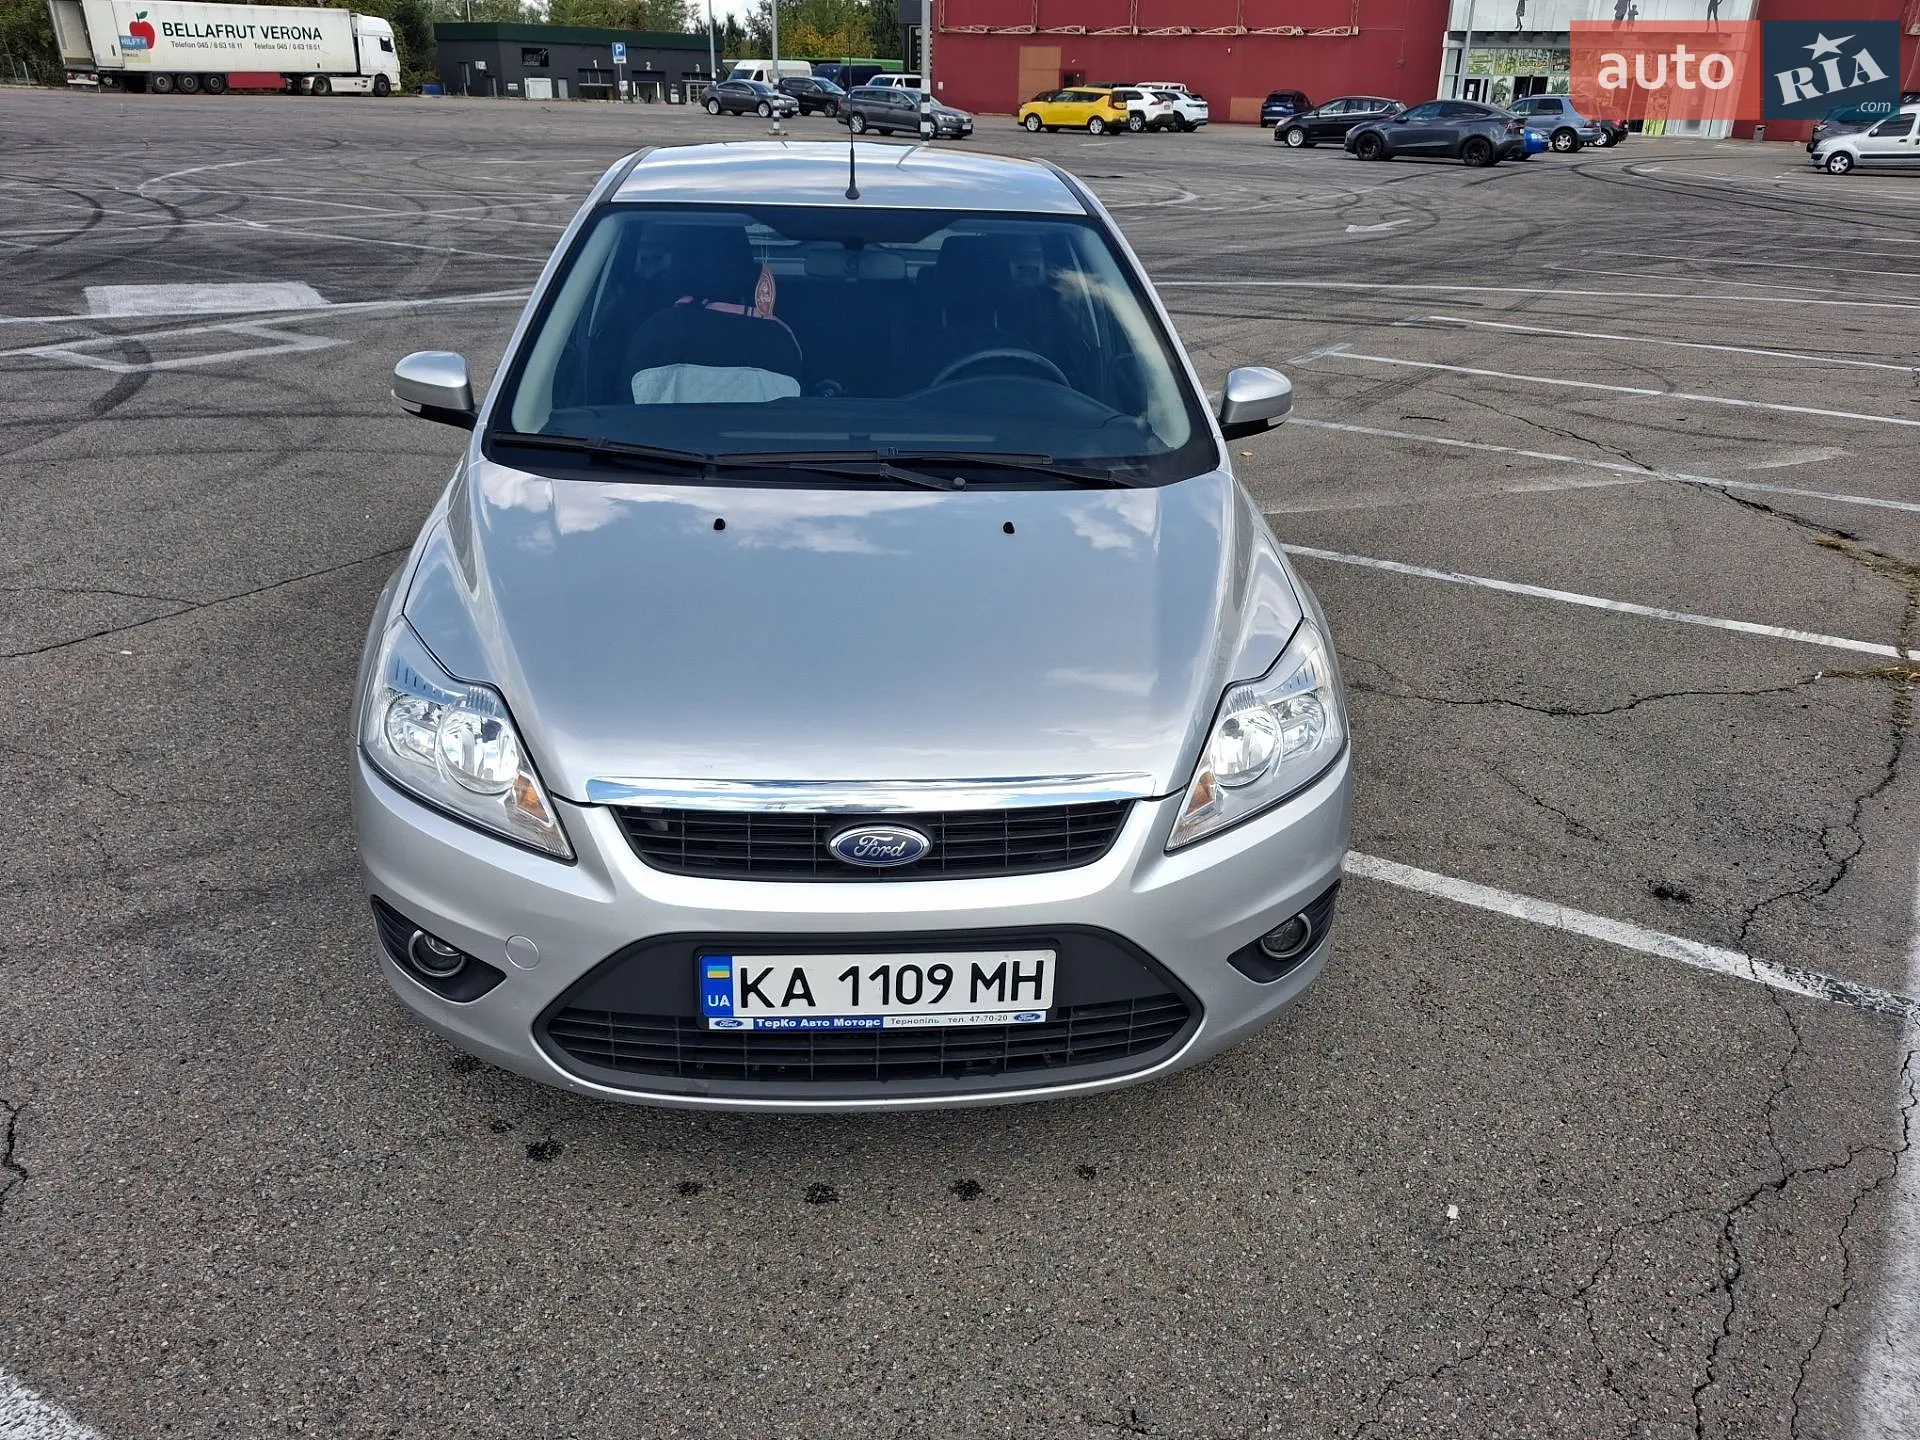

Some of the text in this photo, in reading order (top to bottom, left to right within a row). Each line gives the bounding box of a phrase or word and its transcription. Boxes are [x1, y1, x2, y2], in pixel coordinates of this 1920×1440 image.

[162, 22, 323, 40] BELLAFRUT VERONA
[615, 44, 623, 56] P
[854, 835, 906, 857] Ford
[740, 960, 1044, 1008] KA 1109 MH
[708, 994, 730, 1007] UA
[756, 1017, 881, 1028] ТерКо Авто Моторс
[891, 1016, 940, 1025] Тернопіль
[969, 1014, 1008, 1023] 47-70-20
